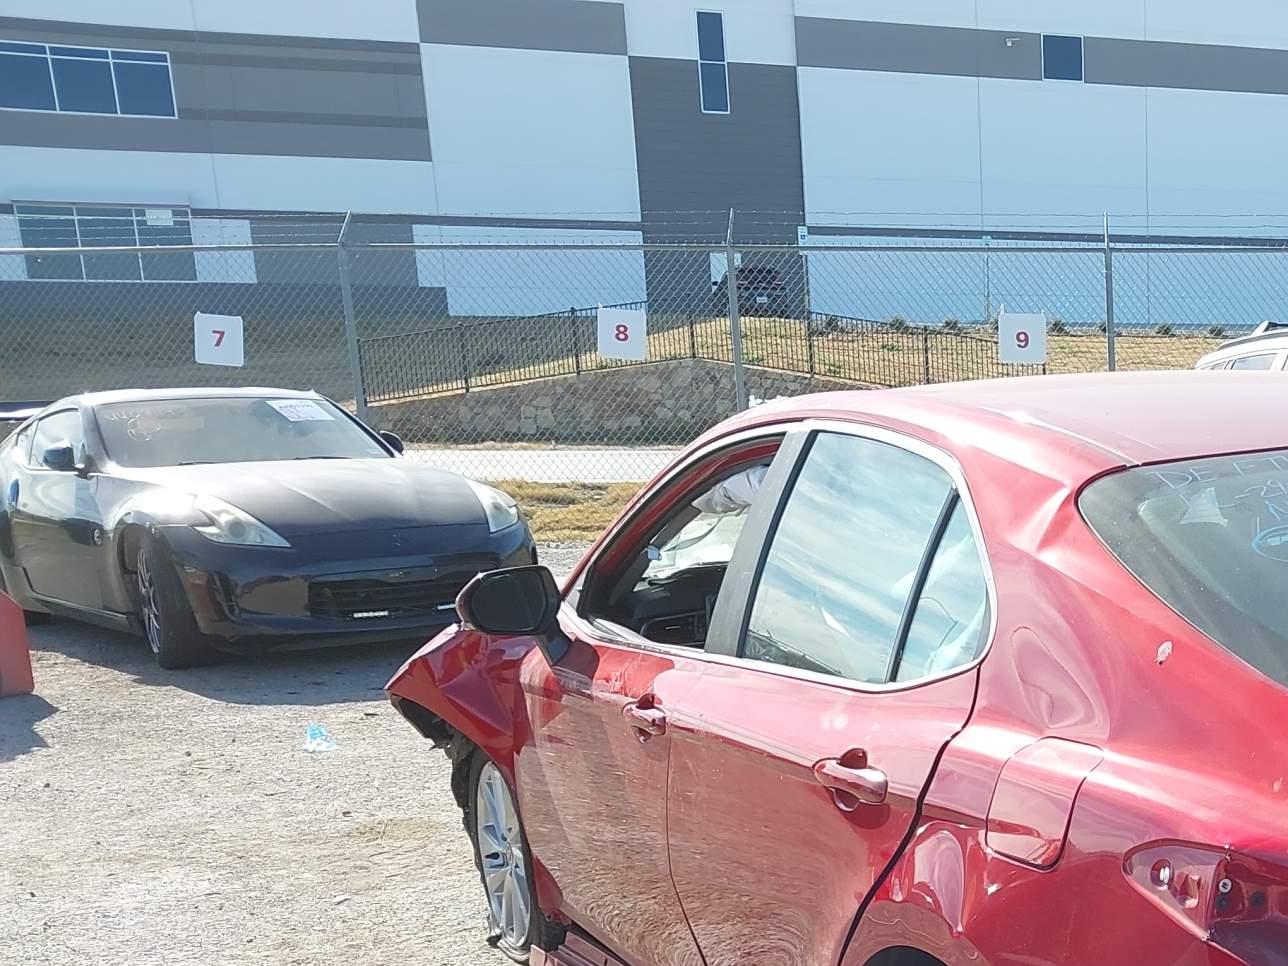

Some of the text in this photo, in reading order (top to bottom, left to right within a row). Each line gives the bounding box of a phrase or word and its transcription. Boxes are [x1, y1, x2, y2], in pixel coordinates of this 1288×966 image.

[212, 329, 226, 348] 7
[615, 324, 629, 342] 8
[1015, 331, 1030, 349] 9
